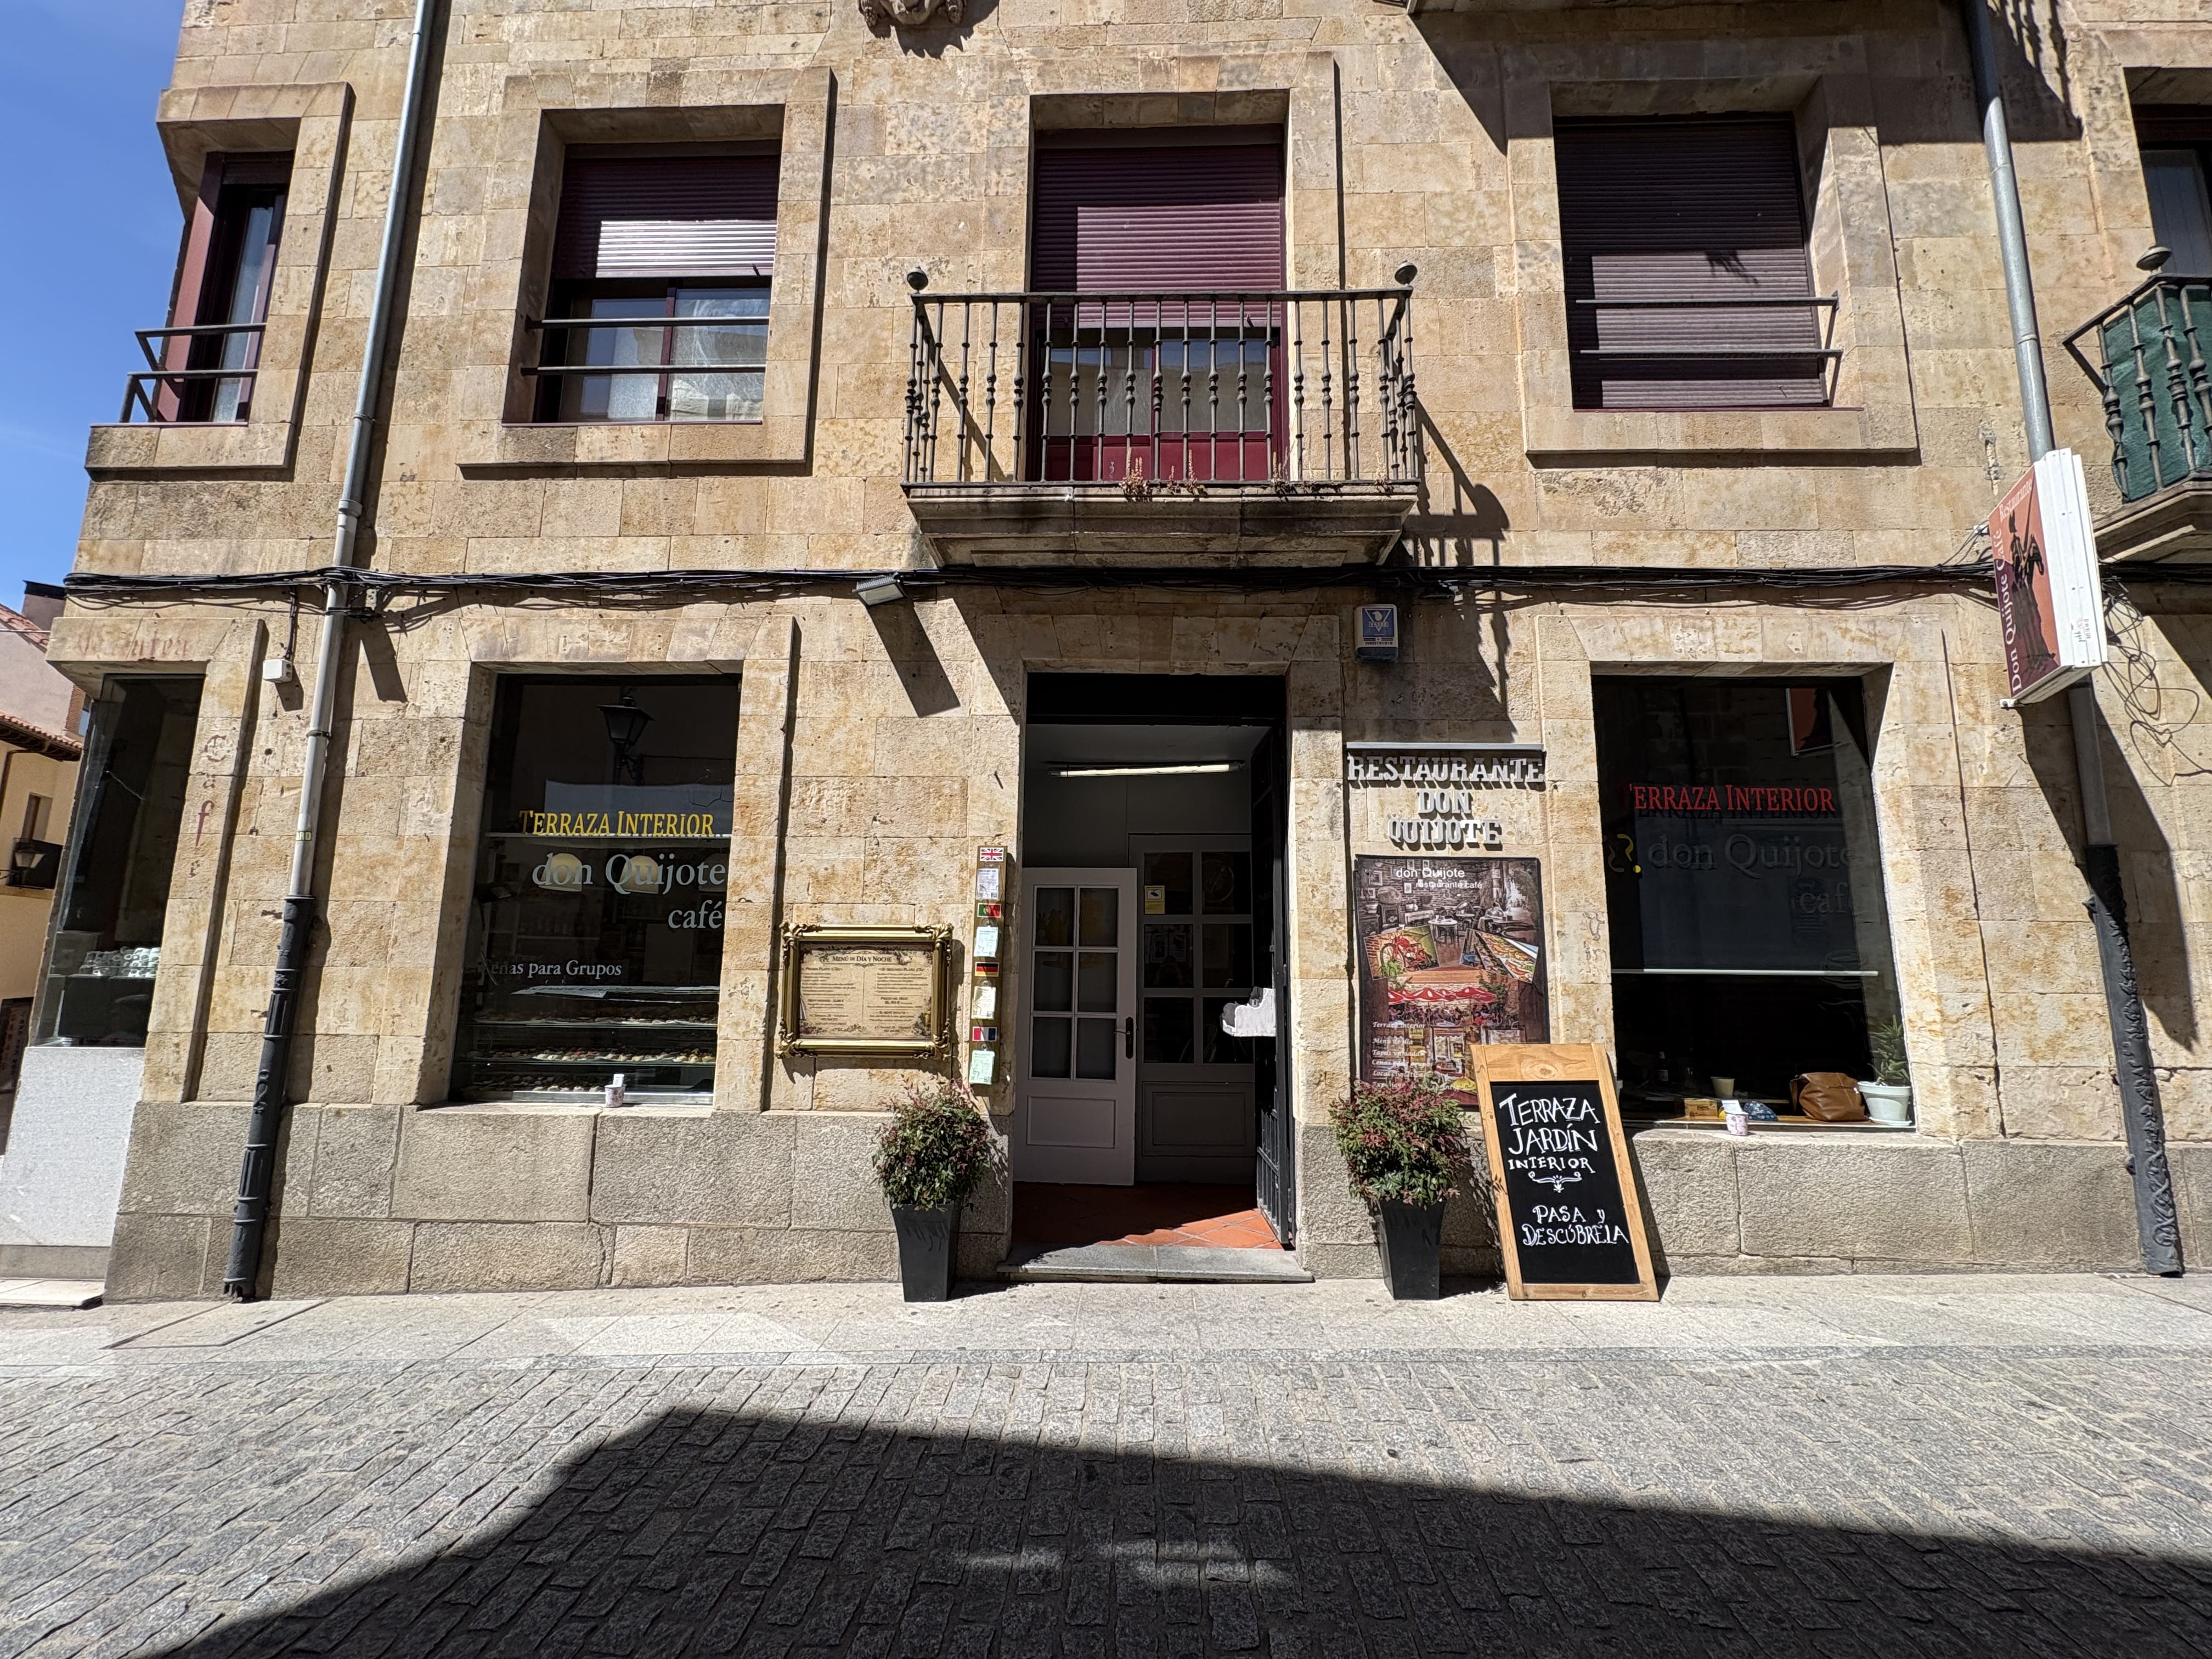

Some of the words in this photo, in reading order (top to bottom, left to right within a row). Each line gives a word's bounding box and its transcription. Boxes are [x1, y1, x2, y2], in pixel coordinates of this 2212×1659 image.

[1999, 478, 2034, 522] Restaurante
[2001, 573, 2016, 645] Quijote
[2010, 647, 2022, 693] Don
[1347, 755, 1545, 782] RESTAURANTE
[1418, 789, 1472, 815] DON
[1725, 785, 1836, 811] INTERIOR
[519, 810, 611, 836] TERRAZA
[616, 810, 714, 836] INTERIOR
[1387, 818, 1500, 844] QUIJOTE
[1647, 834, 1717, 871] don
[532, 852, 593, 886] don
[605, 853, 726, 894] Quijote
[1396, 868, 1418, 877] don
[1422, 867, 1465, 879] Quijote
[1799, 882, 1852, 913] caf
[668, 900, 723, 929] café
[527, 963, 561, 978] para
[566, 960, 622, 979] Grupos
[1499, 1092, 1601, 1126] TERRAZA
[1508, 1123, 1599, 1155] JARDÍN
[1508, 1156, 1596, 1173] INTERIOR
[1532, 1205, 1587, 1224] PASA
[1521, 1223, 1629, 1247] DESCÚBRELA
